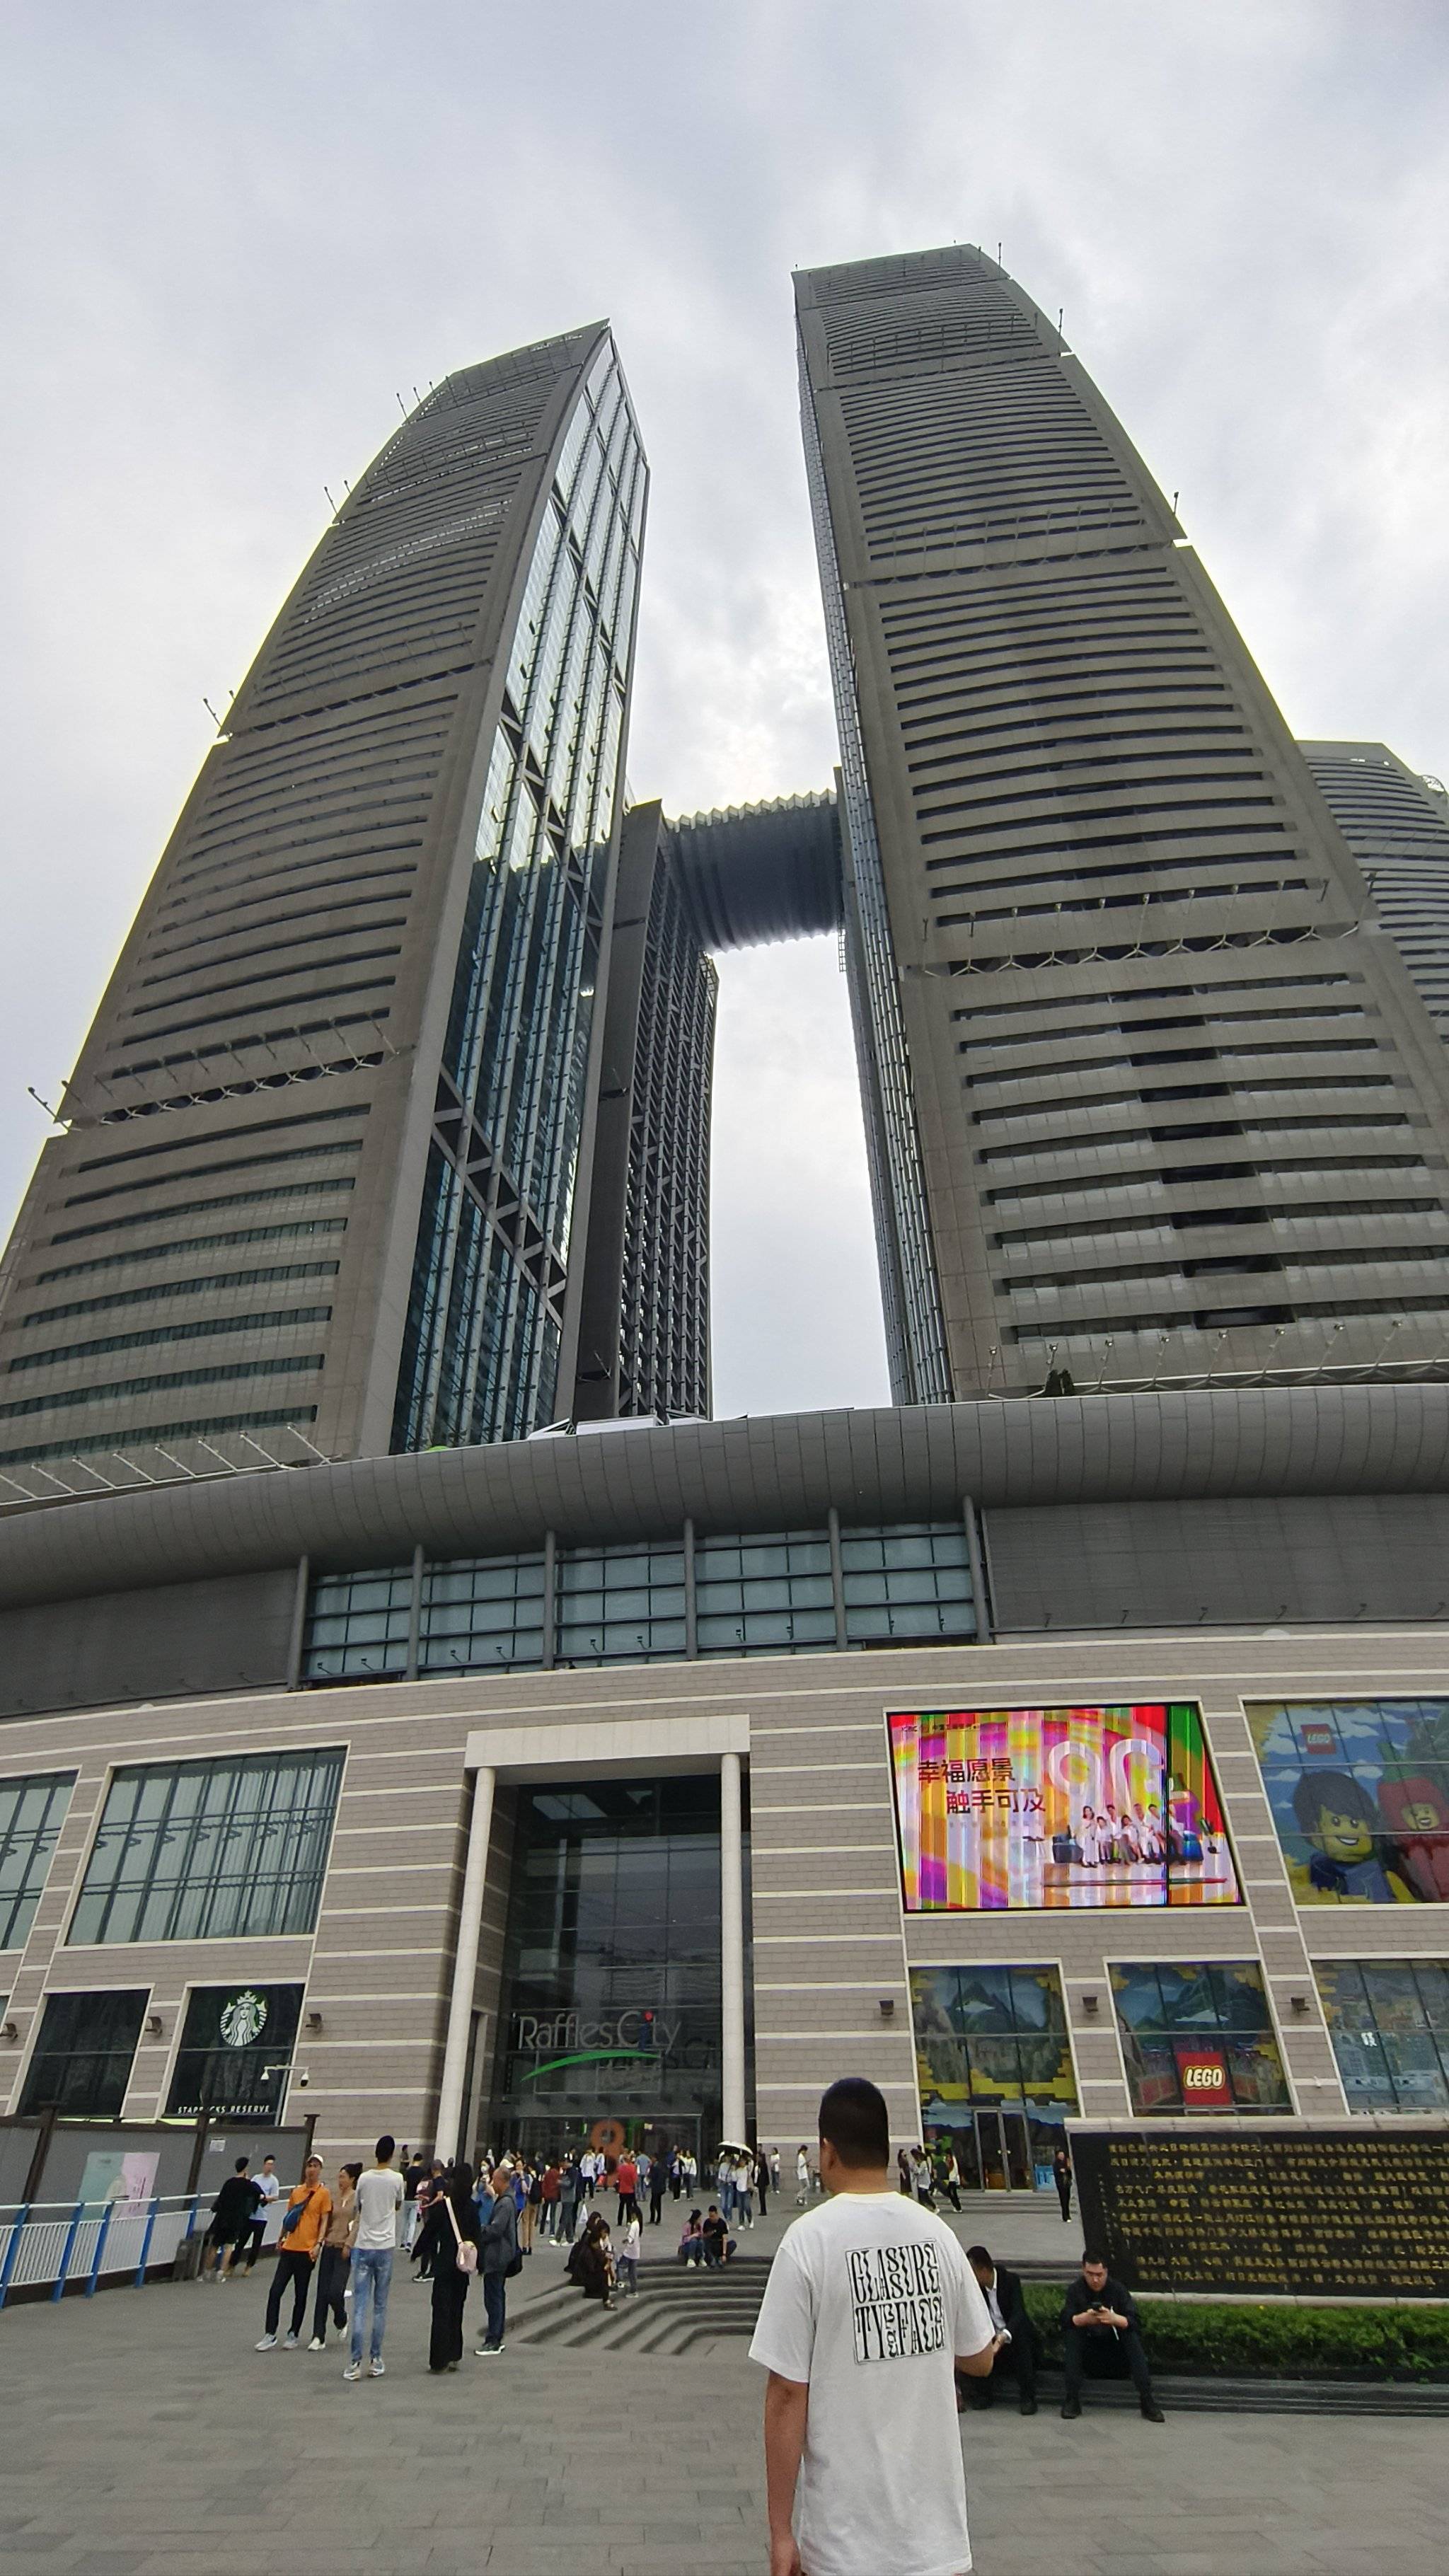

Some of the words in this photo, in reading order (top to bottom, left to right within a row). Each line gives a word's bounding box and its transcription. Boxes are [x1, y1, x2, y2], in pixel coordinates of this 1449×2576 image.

[1307, 1733, 1331, 1744] LEGO
[918, 1757, 1016, 1784] 幸福愿景
[946, 1788, 1046, 1814] 触手可及
[1186, 2067, 1223, 2087] LEGO
[230, 2105, 270, 2113] RESERVE
